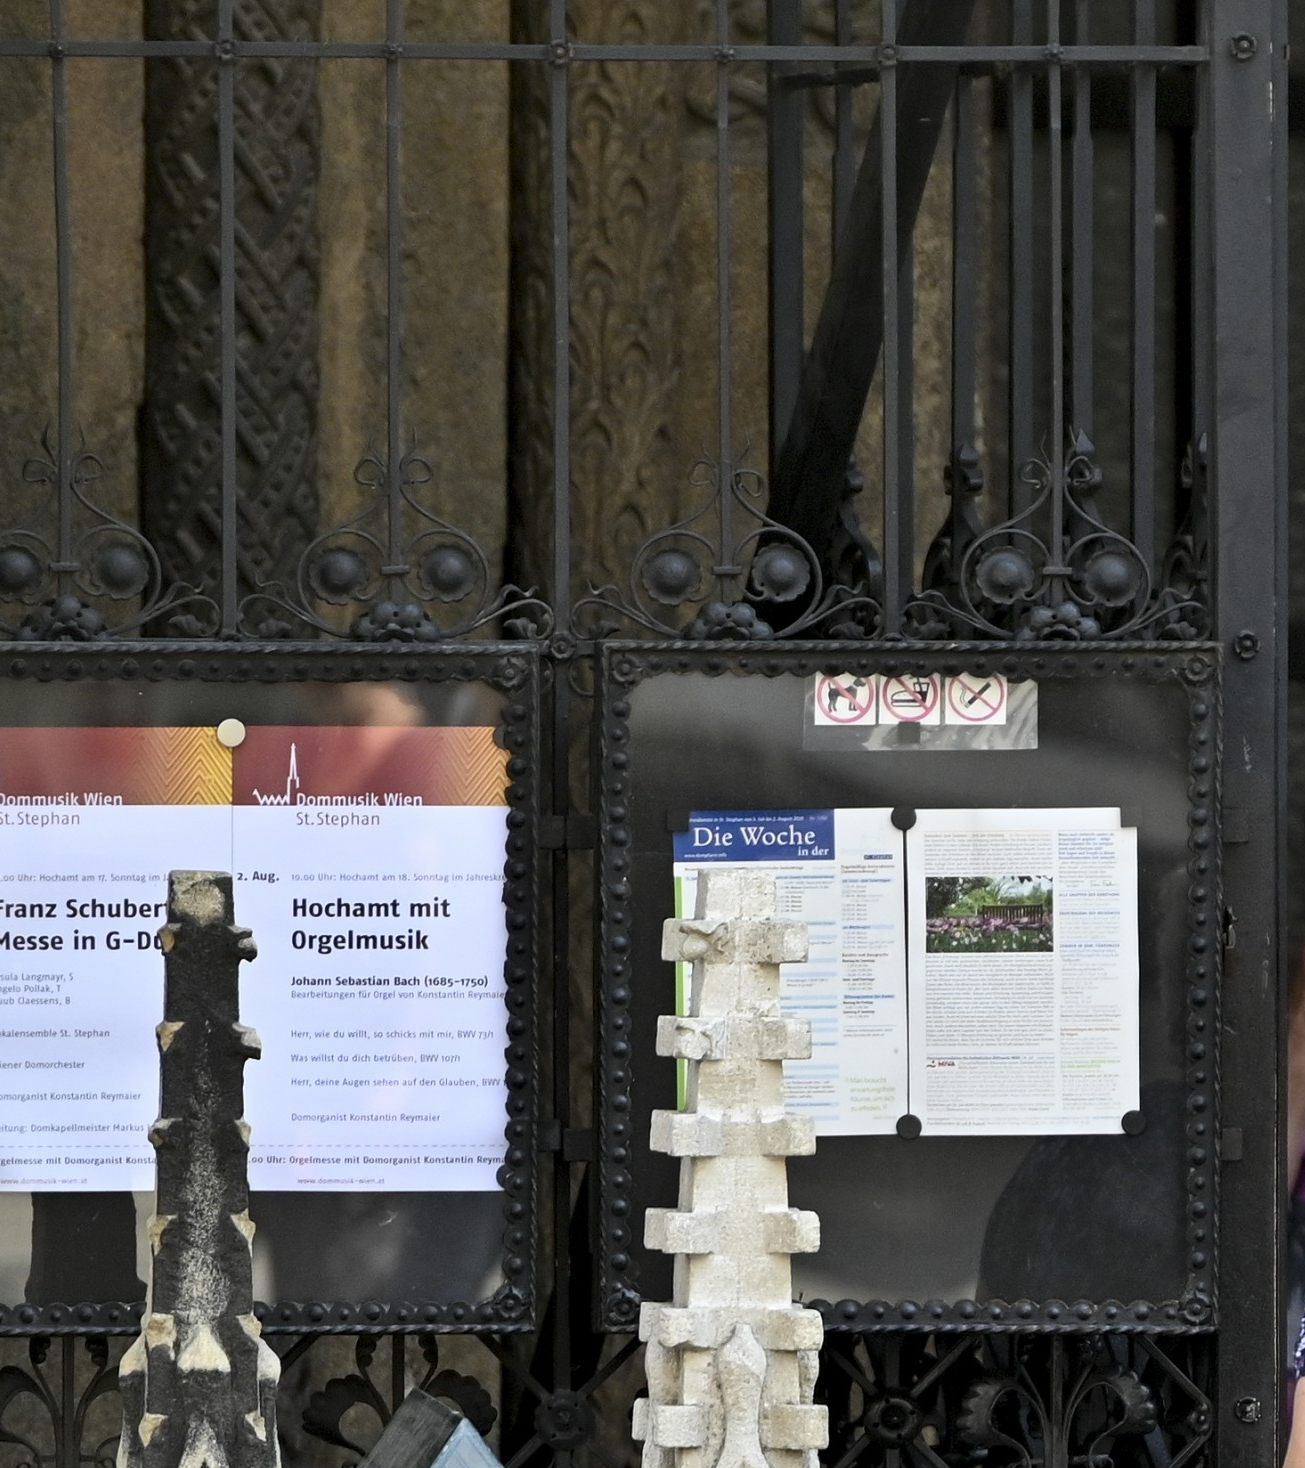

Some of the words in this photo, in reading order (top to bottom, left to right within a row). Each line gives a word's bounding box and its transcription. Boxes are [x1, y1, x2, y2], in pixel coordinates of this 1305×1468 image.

[83, 791, 123, 805] Wien
[296, 792, 379, 805] Dommusik
[383, 792, 423, 805] Wien
[693, 825, 733, 847] Die
[739, 824, 816, 846] Woche
[797, 847, 809, 857] in
[811, 845, 830, 856] der
[39, 873, 79, 882] Hochamt
[237, 872, 248, 881] 2.
[252, 870, 280, 884] Aug.
[339, 873, 379, 882] Hochamt
[65, 898, 168, 919] Schuber
[292, 897, 401, 918] Hochamt
[409, 896, 451, 918] mit
[73, 929, 96, 950] in
[291, 928, 429, 955] Orgelmusik
[0, 972, 19, 982] sula
[291, 976, 332, 986] Johann
[335, 975, 390, 986] Sebastian
[393, 976, 420, 986] Bach
[291, 989, 356, 1001] Bearbeitungen
[358, 989, 371, 999] für
[373, 990, 396, 1001] Orgel
[397, 991, 415, 999] von
[417, 990, 465, 999] Konstantin
[0, 1028, 58, 1038] kalensemble
[59, 1029, 71, 1038] St.
[74, 1028, 110, 1039] Stephan
[290, 1029, 312, 1040] Herr,
[314, 1030, 331, 1039] wie
[333, 1030, 345, 1039] du
[385, 1030, 417, 1039] schicks
[419, 1030, 434, 1039] mit
[436, 1030, 454, 1040] mir,
[457, 1030, 477, 1039] BWV
[290, 1053, 309, 1063] Was
[310, 1053, 335, 1063] willst
[337, 1053, 349, 1063] du
[351, 1053, 371, 1063] dich
[373, 1054, 417, 1064] betrüben,
[420, 1053, 439, 1063] BWV
[0, 1060, 23, 1070] iener
[24, 1060, 85, 1070] Domorchester
[290, 1078, 312, 1088] Herr,
[314, 1078, 340, 1086] deine
[342, 1077, 370, 1088] Augen
[372, 1078, 399, 1087] sehen
[402, 1077, 417, 1087] auf
[419, 1077, 437, 1087] den
[438, 1077, 479, 1087] Glauben,
[482, 1078, 501, 1087] BWV
[0, 1092, 48, 1103] omorganist
[49, 1092, 98, 1101] Konstantin
[100, 1091, 141, 1103] Reymaier
[291, 1112, 347, 1124] Domorganist
[349, 1113, 397, 1122] Konstantin
[400, 1112, 441, 1124] Reymaier
[30, 1123, 110, 1134] Domkapellmeister
[112, 1123, 144, 1132] Markus
[0, 1156, 43, 1168] gelmesse
[45, 1156, 62, 1165] mit
[64, 1156, 123, 1167] Domorganist
[266, 1155, 286, 1164] Uhr:
[289, 1155, 341, 1166] Orgelmesse
[344, 1156, 360, 1164] mit
[363, 1155, 421, 1166] Domorganist
[423, 1155, 474, 1164] Konstantin
